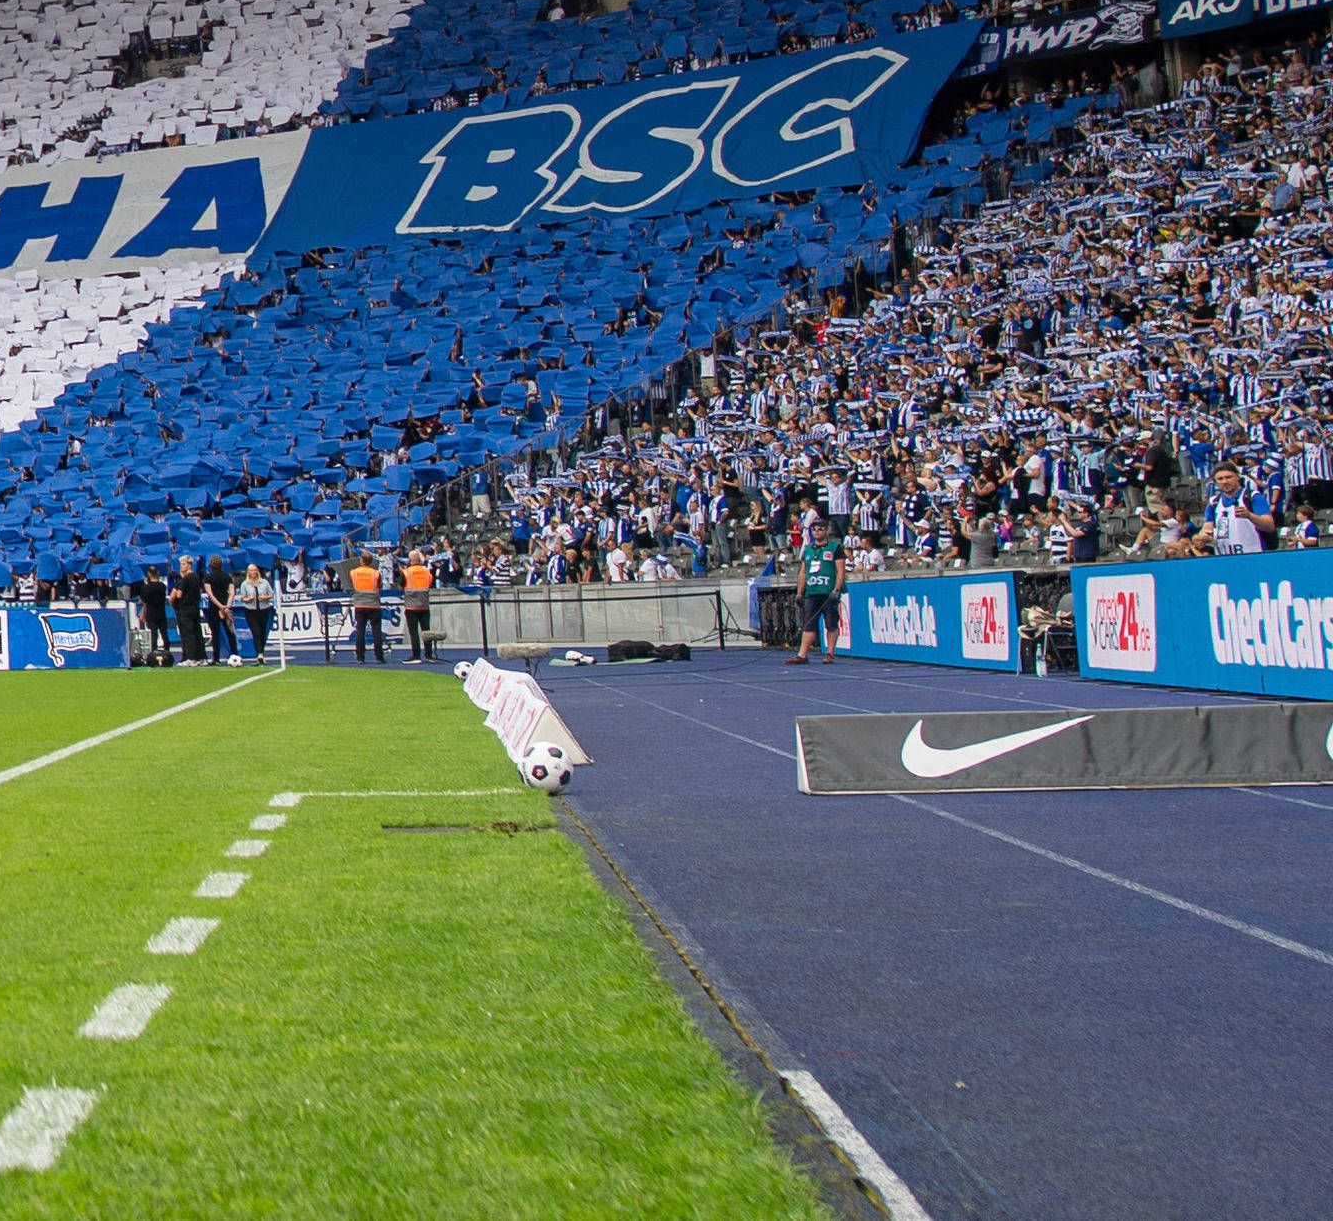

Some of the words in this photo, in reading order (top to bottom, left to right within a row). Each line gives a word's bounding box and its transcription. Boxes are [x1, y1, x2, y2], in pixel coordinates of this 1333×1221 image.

[395, 47, 910, 235] BSC
[867, 595, 938, 648] CheckCars24.de
[982, 596, 997, 645] 24
[1117, 591, 1139, 651] 24
